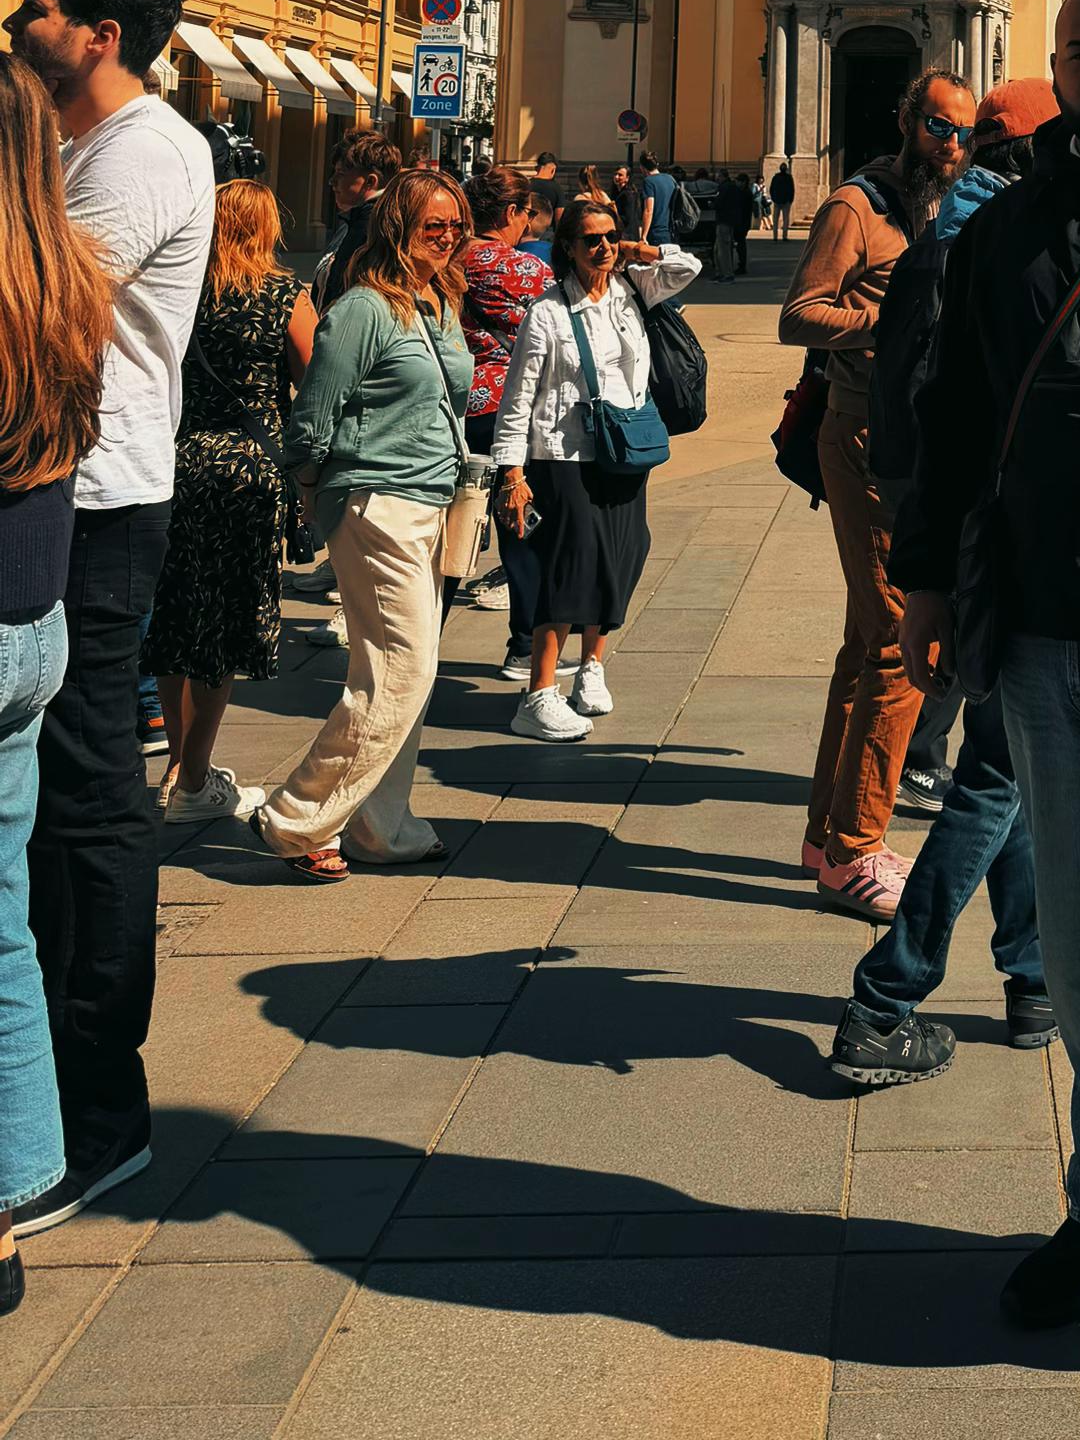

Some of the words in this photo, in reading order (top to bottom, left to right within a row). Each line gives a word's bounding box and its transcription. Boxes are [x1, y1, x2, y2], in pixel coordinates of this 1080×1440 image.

[441, 79, 456, 93] 20
[421, 98, 453, 111] Zone
[905, 768, 935, 790] HOKA
